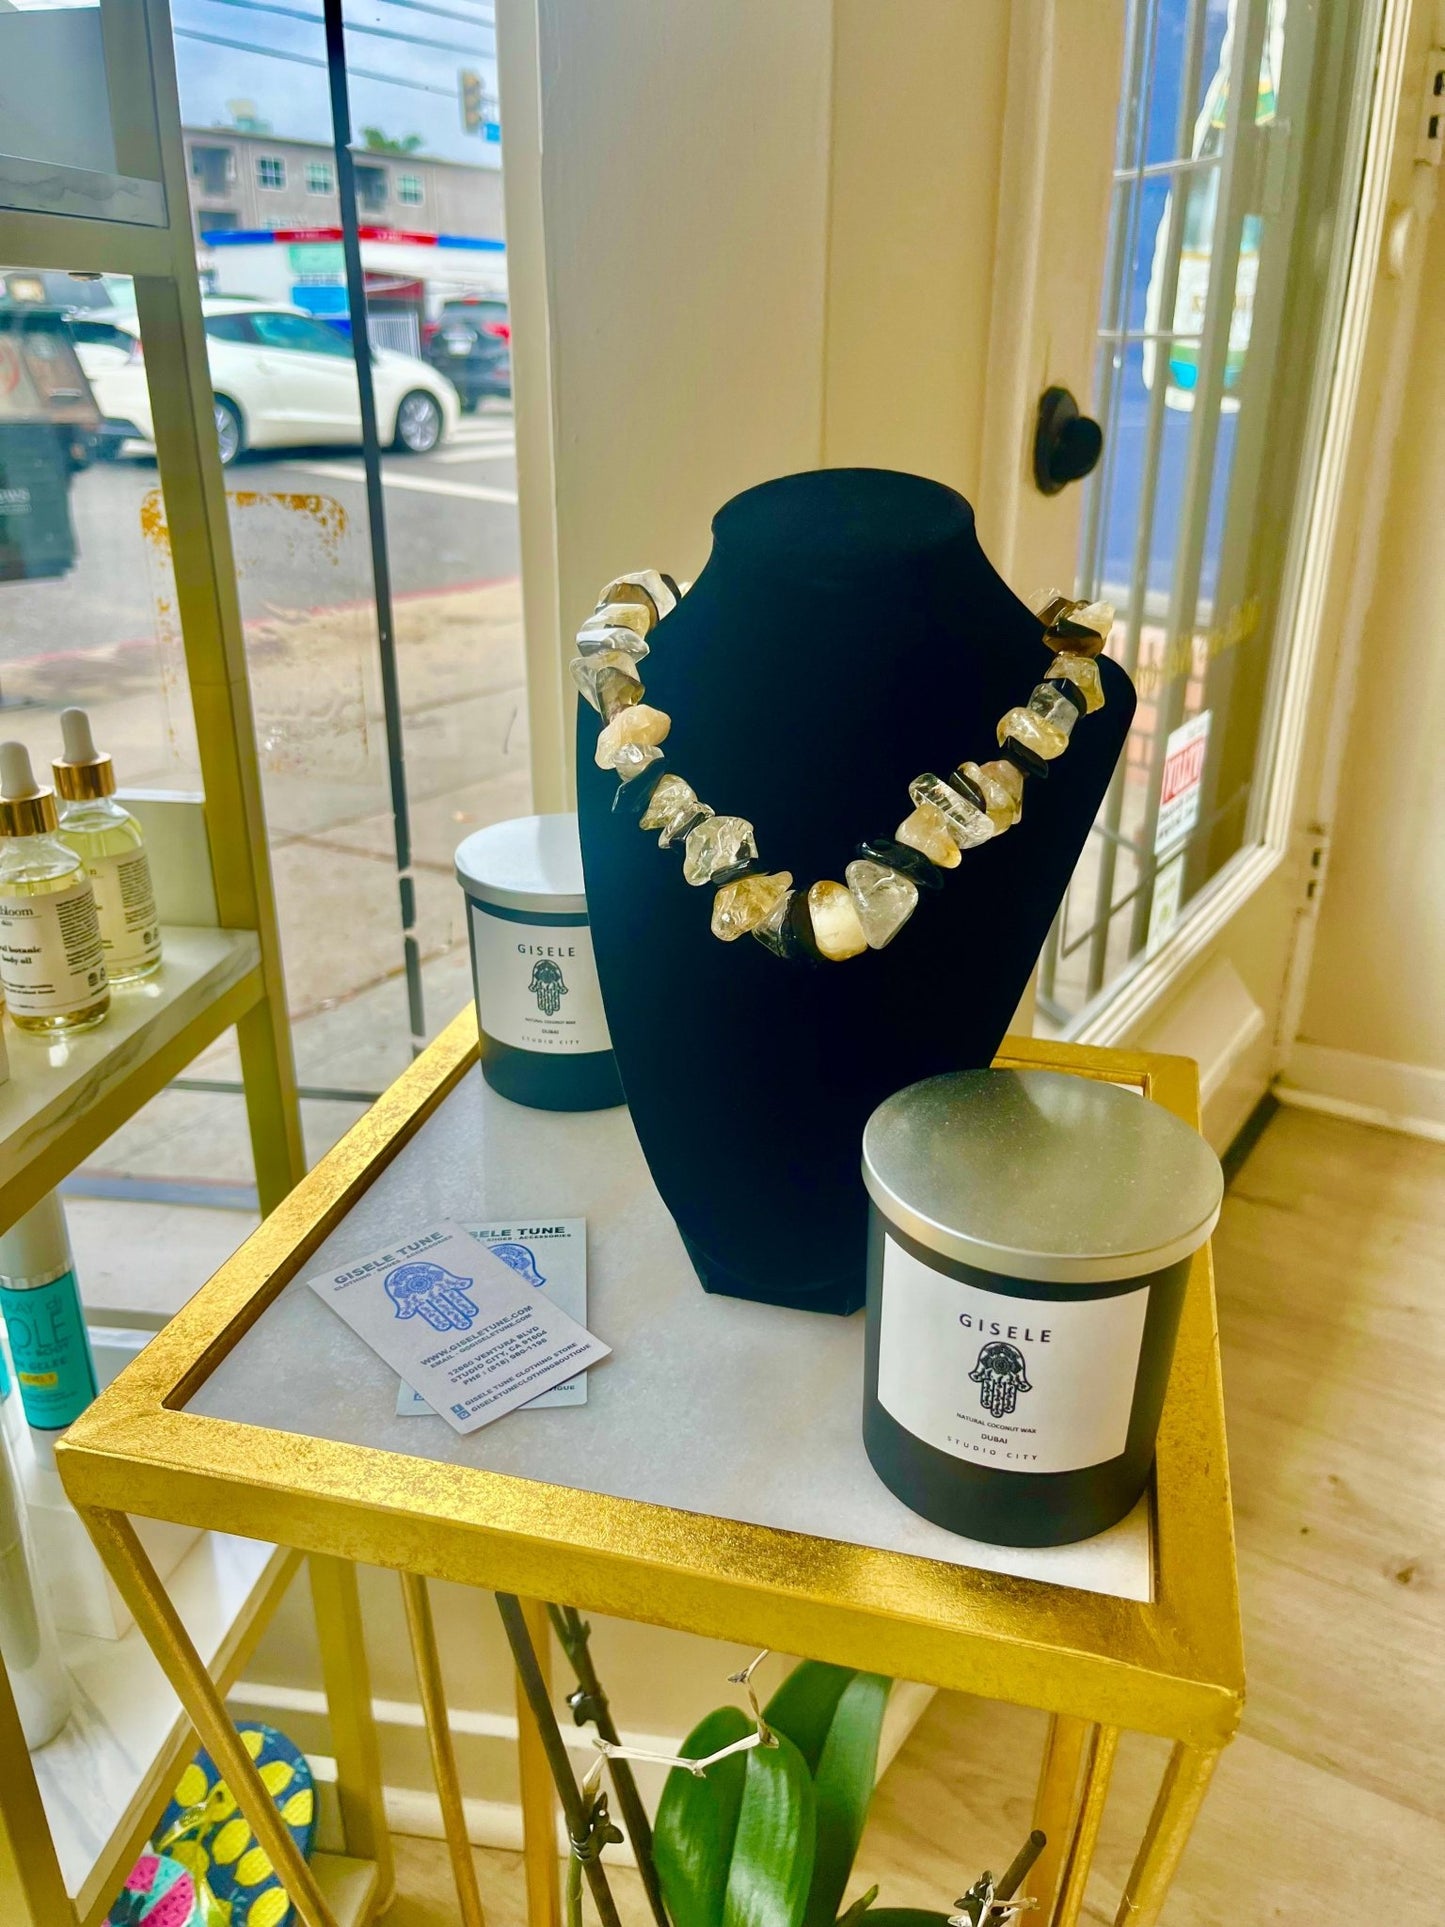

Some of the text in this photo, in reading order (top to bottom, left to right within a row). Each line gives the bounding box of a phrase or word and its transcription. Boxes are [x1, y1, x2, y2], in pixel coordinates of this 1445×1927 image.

[517, 943, 576, 957] GISELE
[469, 1226, 566, 1238] SELE TUNE
[332, 1231, 444, 1285] GISELE TUNE
[420, 1304, 533, 1365] WWW.GISELETUNE.COM
[959, 1313, 1052, 1343] GISELE
[450, 1329, 547, 1383] STUDIO CITY, CA 91604
[474, 1337, 516, 1361] VENTURA
[516, 1325, 540, 1339] BLVD
[429, 1353, 455, 1368] EMAIL
[464, 1341, 578, 1406] GISELE TUNE CLOTHING STORE
[956, 1412, 986, 1427] NATURAL
[986, 1422, 1020, 1433] COCONUT
[947, 1436, 1038, 1461] STUDIO CITY
[980, 1433, 1008, 1444] DUBAI
